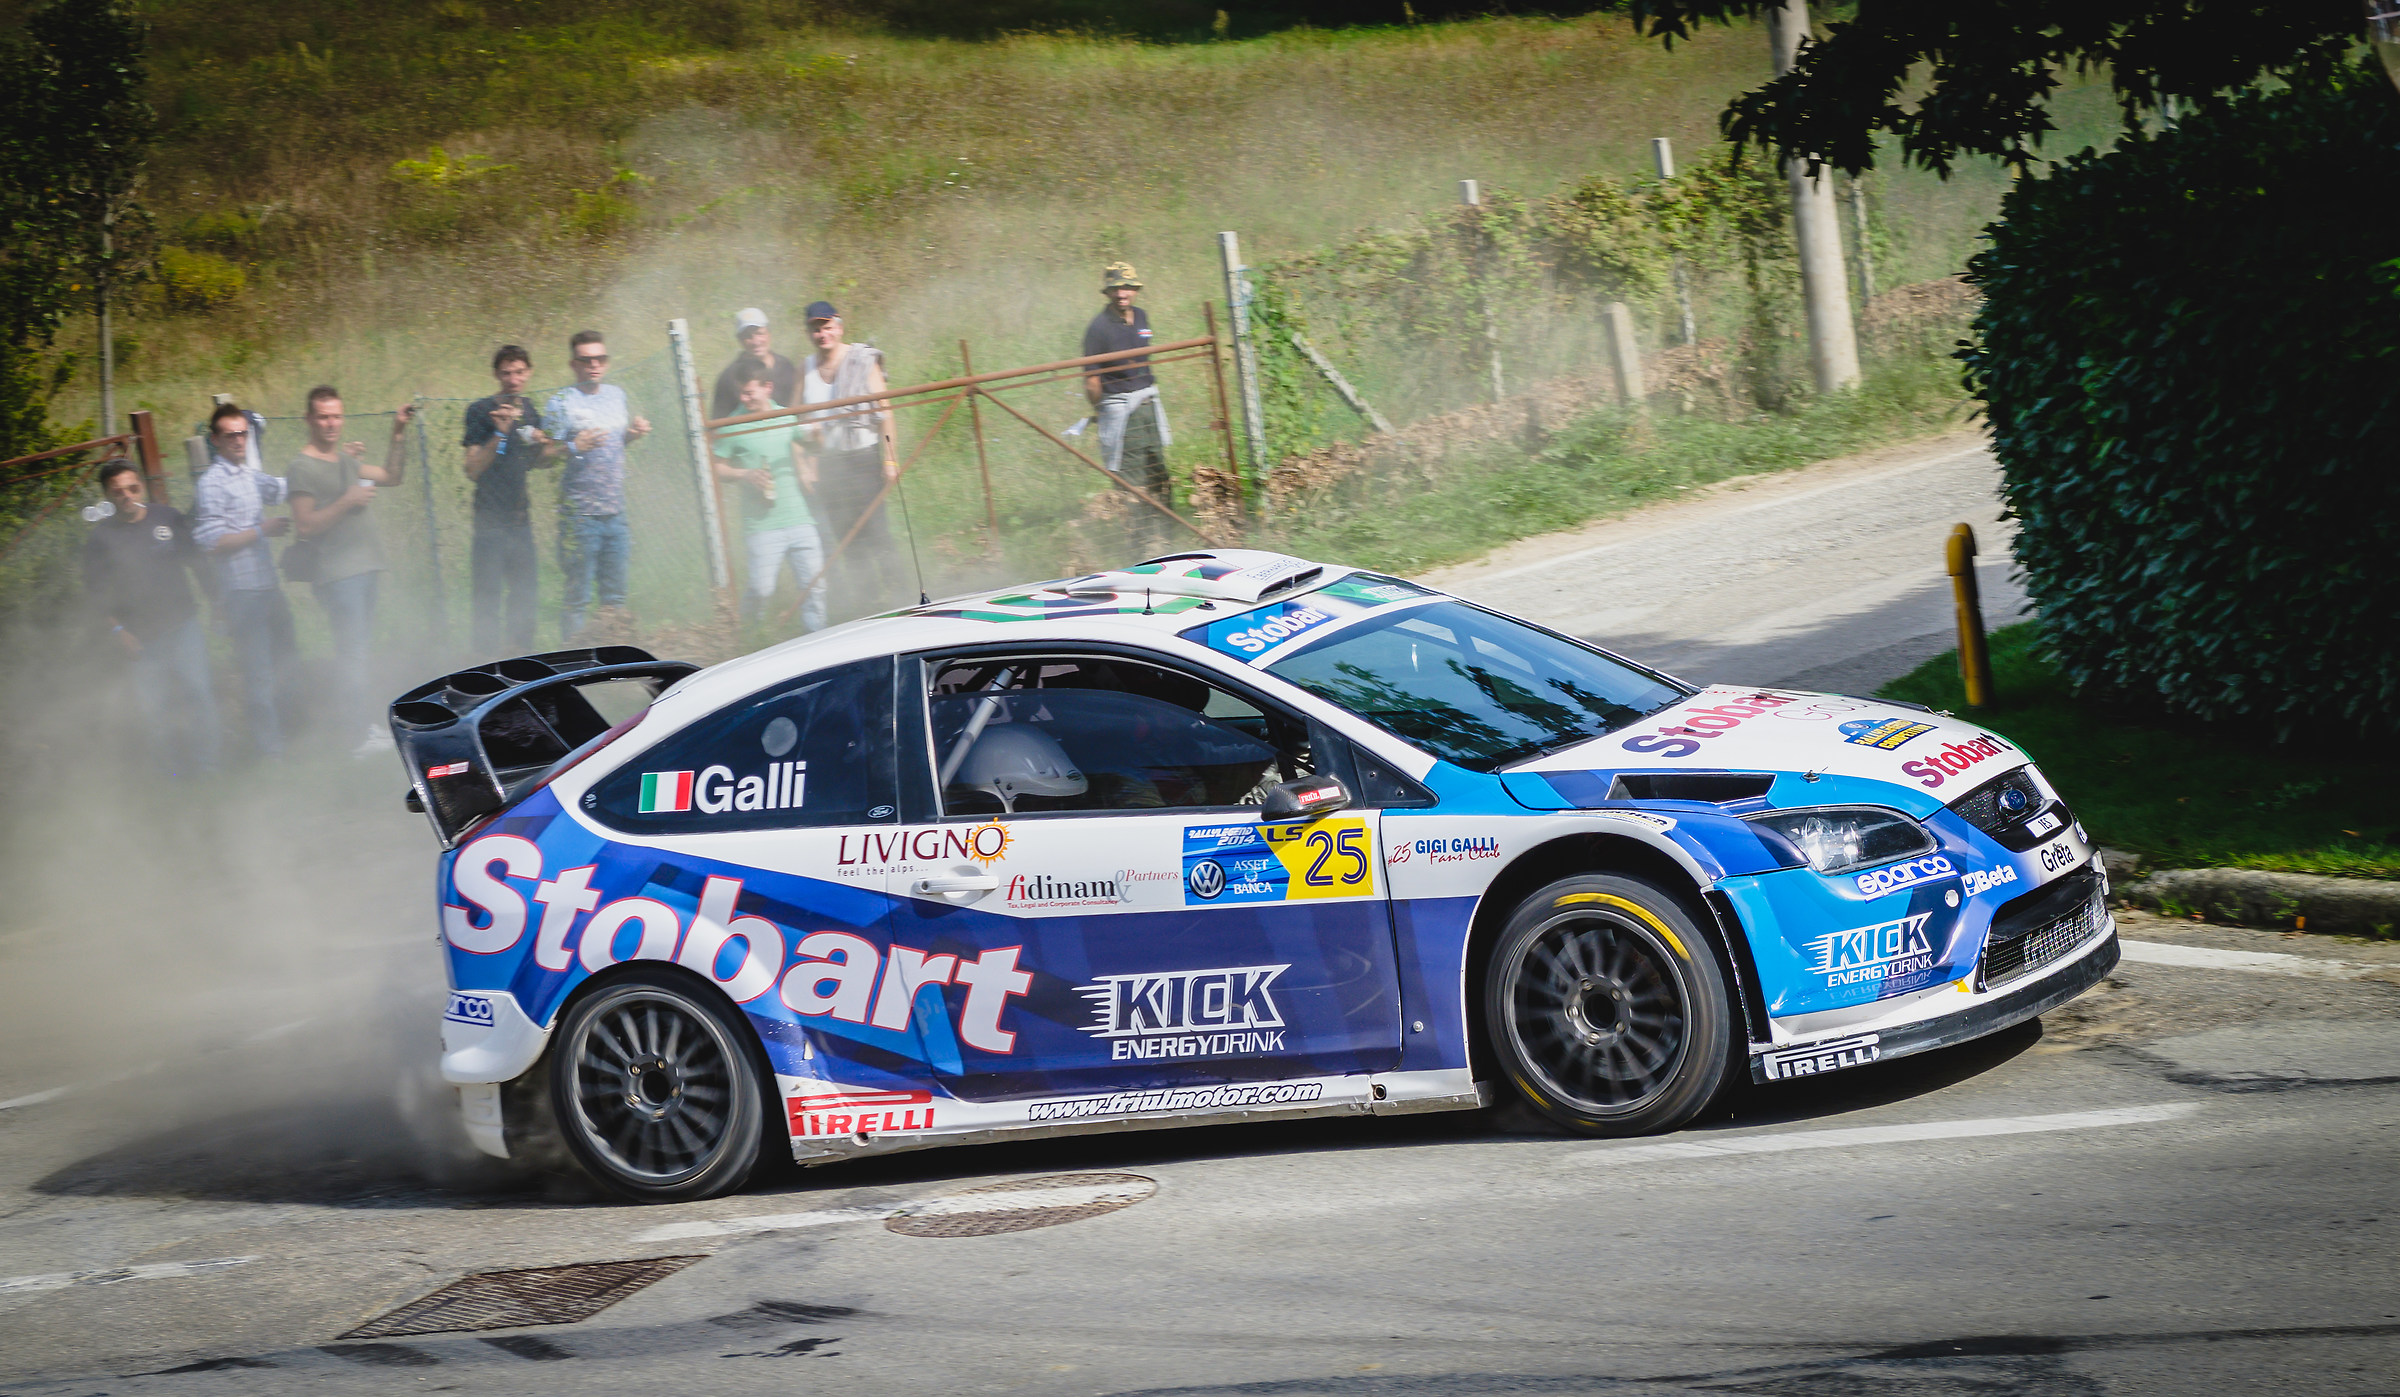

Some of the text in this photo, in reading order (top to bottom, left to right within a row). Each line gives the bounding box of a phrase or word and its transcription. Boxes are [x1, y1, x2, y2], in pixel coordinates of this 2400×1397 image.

[1901, 732, 2014, 789] Stobart
[694, 760, 807, 814] Galli
[837, 827, 1004, 866] LIVIGNO
[1217, 834, 1256, 847] 2014
[1266, 826, 1303, 843] LS
[1415, 837, 1495, 854] GIGI GALLI
[837, 867, 860, 877] feel
[867, 866, 884, 876] the
[1233, 858, 1270, 871] ASSET
[1305, 828, 1368, 887] 25
[1430, 844, 1501, 865] Fans Club
[1003, 874, 1118, 901] fidinam
[1125, 869, 1179, 882] Partners
[1233, 881, 1273, 895] BANCA
[1857, 855, 1951, 896] sparco
[1978, 864, 2018, 891] Beta
[1021, 902, 1036, 910] Legal
[443, 832, 1035, 1056] Stobart
[1826, 912, 1933, 972] KICK
[1828, 953, 1933, 988] ENERGYDRINK
[1107, 964, 1292, 1037] KICK
[1112, 1030, 1286, 1060] ENERGYDRINK
[1763, 1033, 1880, 1080] PIRELLI
[787, 1089, 935, 1137] PIRELLI
[1029, 1082, 1323, 1122] www.friulmotor.com
